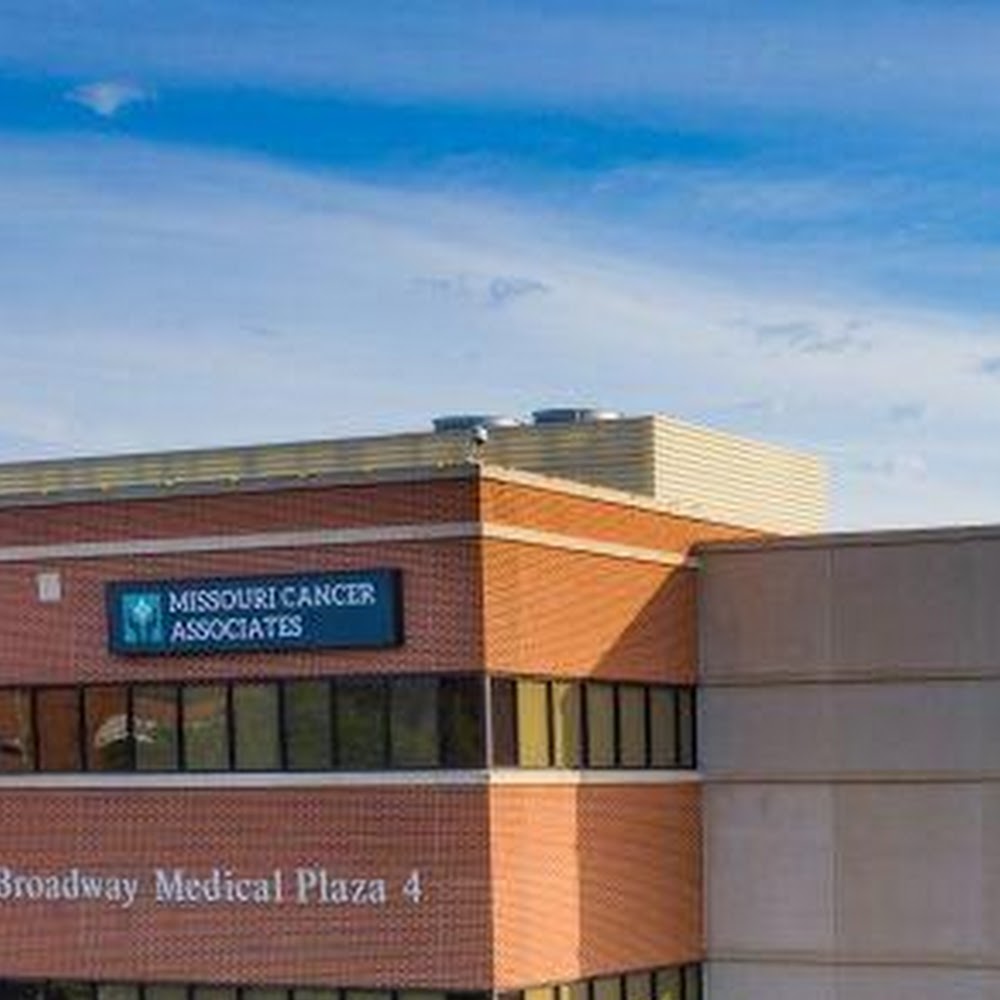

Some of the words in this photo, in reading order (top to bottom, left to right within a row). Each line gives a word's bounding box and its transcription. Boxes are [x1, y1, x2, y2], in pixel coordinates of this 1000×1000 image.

[169, 586, 276, 613] MISSOURI
[281, 582, 376, 608] CANCER
[170, 615, 303, 642] ASSOCIATES
[0, 867, 138, 908] Broadway
[155, 867, 283, 903] Medical
[296, 868, 386, 903] Plaza
[403, 868, 423, 903] 4
